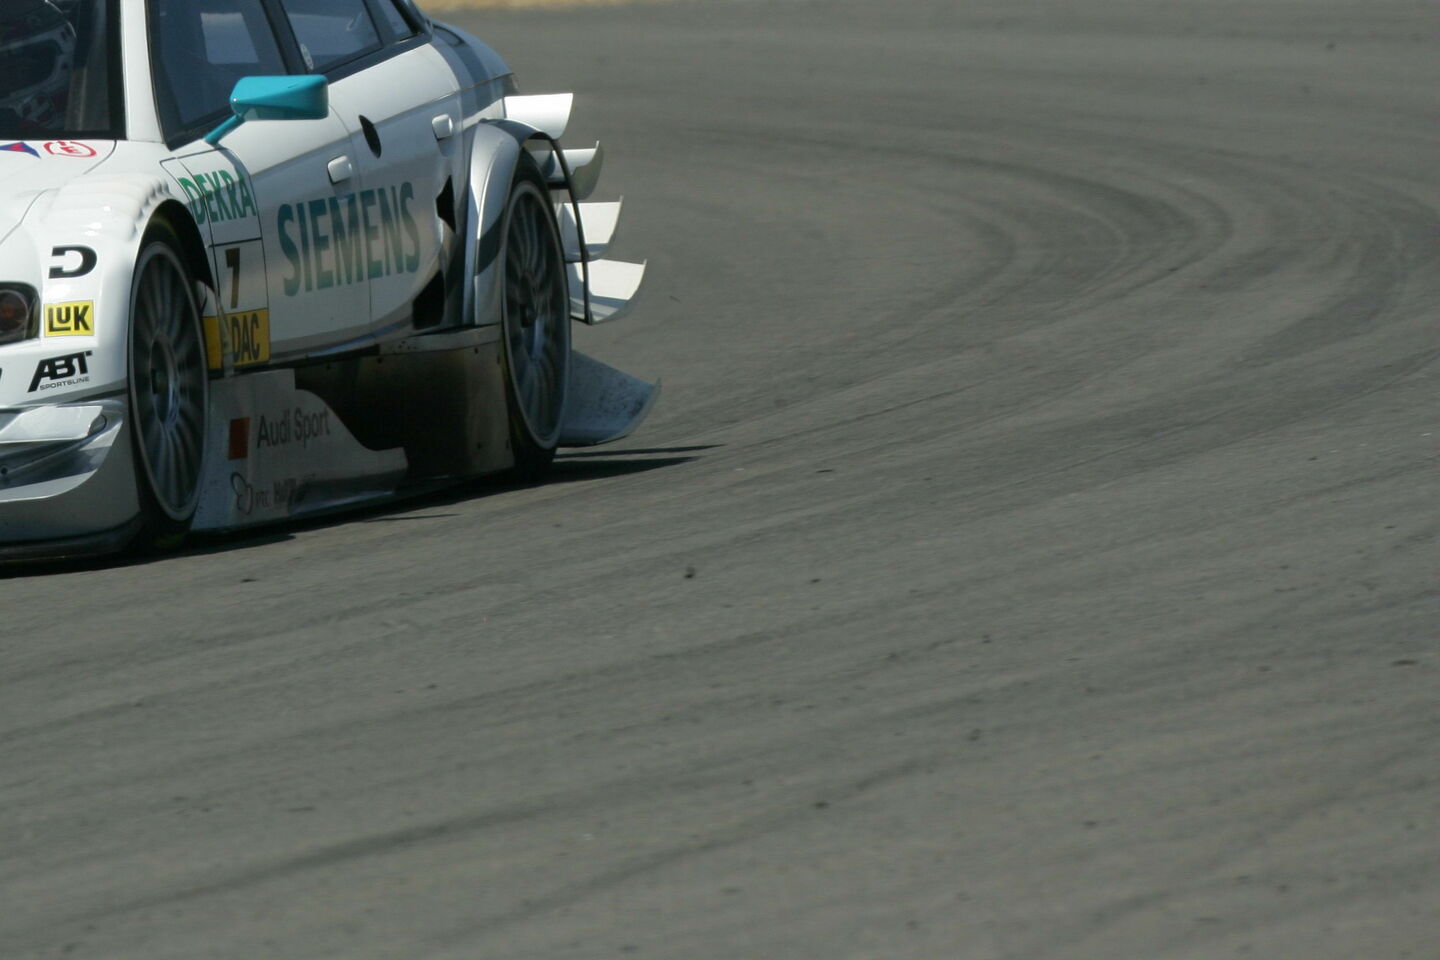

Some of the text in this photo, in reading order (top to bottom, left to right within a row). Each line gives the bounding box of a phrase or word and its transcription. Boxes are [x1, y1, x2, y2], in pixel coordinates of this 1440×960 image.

[178, 168, 257, 225] DEKRA
[277, 182, 421, 297] SIEMENS
[225, 247, 241, 309] 7
[27, 351, 93, 393] ABT
[256, 406, 331, 449] Audi Sport
